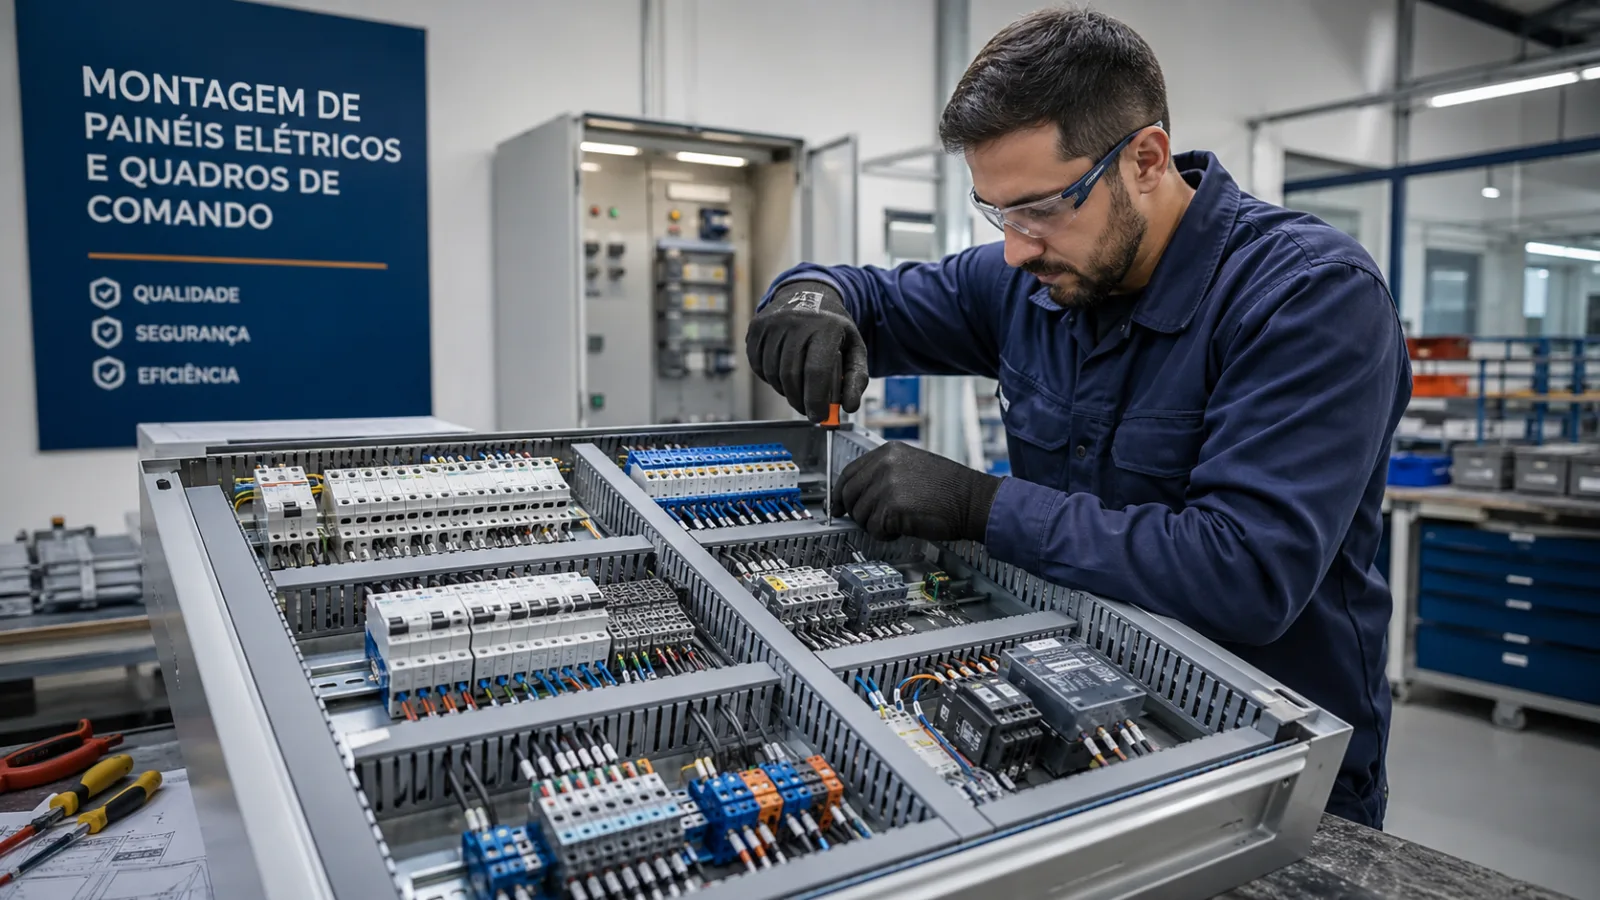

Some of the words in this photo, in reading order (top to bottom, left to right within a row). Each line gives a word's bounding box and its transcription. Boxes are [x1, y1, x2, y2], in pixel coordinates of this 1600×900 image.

[82, 65, 305, 117] MONTAGEM
[317, 90, 361, 122] DE
[85, 111, 224, 149] PAINÉIS
[235, 122, 402, 163] ELÉTRICOS
[87, 153, 109, 181] E
[119, 156, 290, 192] QUADROS
[299, 168, 340, 195] DE
[87, 195, 273, 230] COMANDO
[133, 285, 240, 304] QUALIDADE
[135, 325, 250, 346] SEGURANÇA
[137, 364, 240, 385] EFICIÊNCIA
